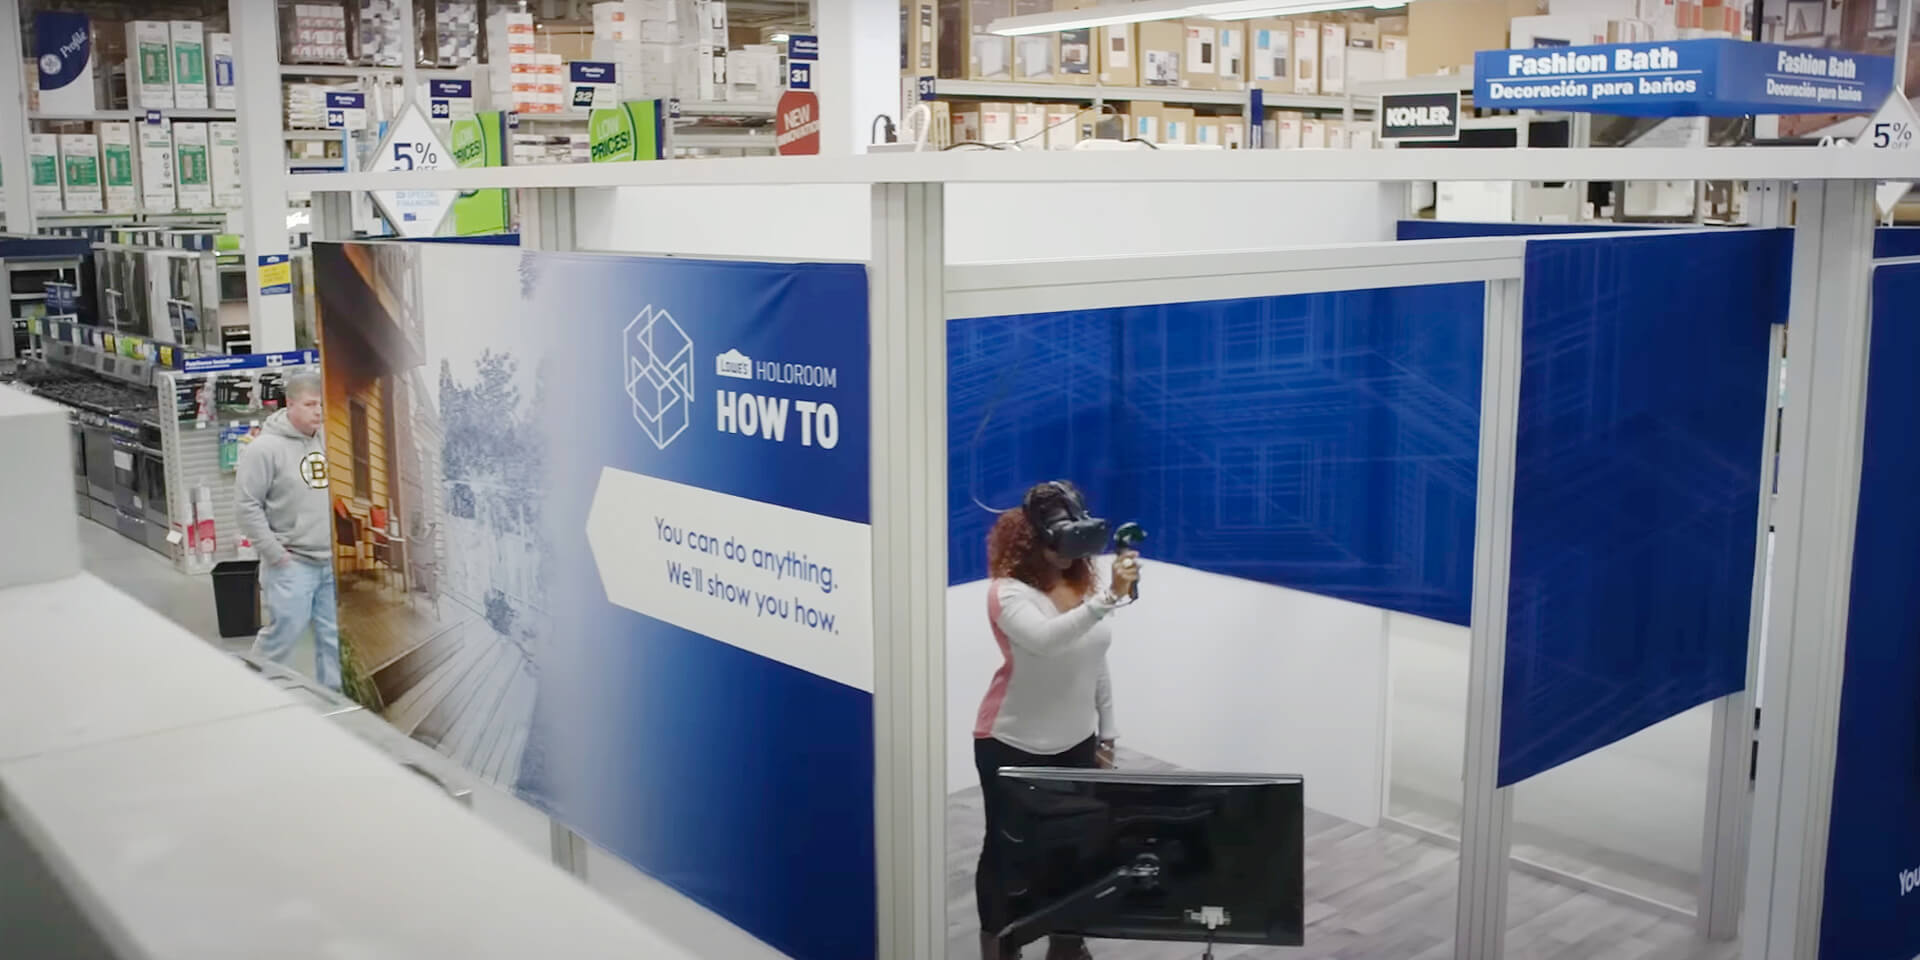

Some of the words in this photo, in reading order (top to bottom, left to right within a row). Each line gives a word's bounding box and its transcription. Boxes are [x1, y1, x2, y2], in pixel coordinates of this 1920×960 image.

[60, 30, 88, 58] Profile
[1508, 52, 1608, 76] Fashion
[1614, 46, 1679, 71] Bath
[1777, 50, 1827, 77] Fashion
[1828, 56, 1857, 79] Bath
[791, 69, 809, 83] 31
[919, 80, 935, 95] 31
[1490, 79, 1588, 100] Decoración
[1591, 80, 1634, 99] para
[1638, 76, 1697, 94] baños
[575, 89, 595, 103] 32
[1766, 78, 1817, 98] Decoración
[1817, 87, 1838, 102] para
[1838, 85, 1863, 102] baños
[328, 113, 344, 123] 34
[432, 104, 449, 114] 33
[783, 103, 811, 131] NEW
[1873, 122, 1912, 148] 5%
[392, 142, 437, 172] 5%
[756, 360, 837, 389] HOLOROOM
[716, 389, 790, 442] HOW
[795, 400, 839, 450] TO
[310, 460, 326, 480] B
[655, 515, 683, 546] You
[687, 531, 720, 557] can
[724, 535, 747, 564] do
[752, 548, 839, 594] anything.
[667, 559, 704, 593] We'll
[707, 573, 750, 608] show
[755, 592, 789, 619] you
[795, 597, 840, 636] how.
